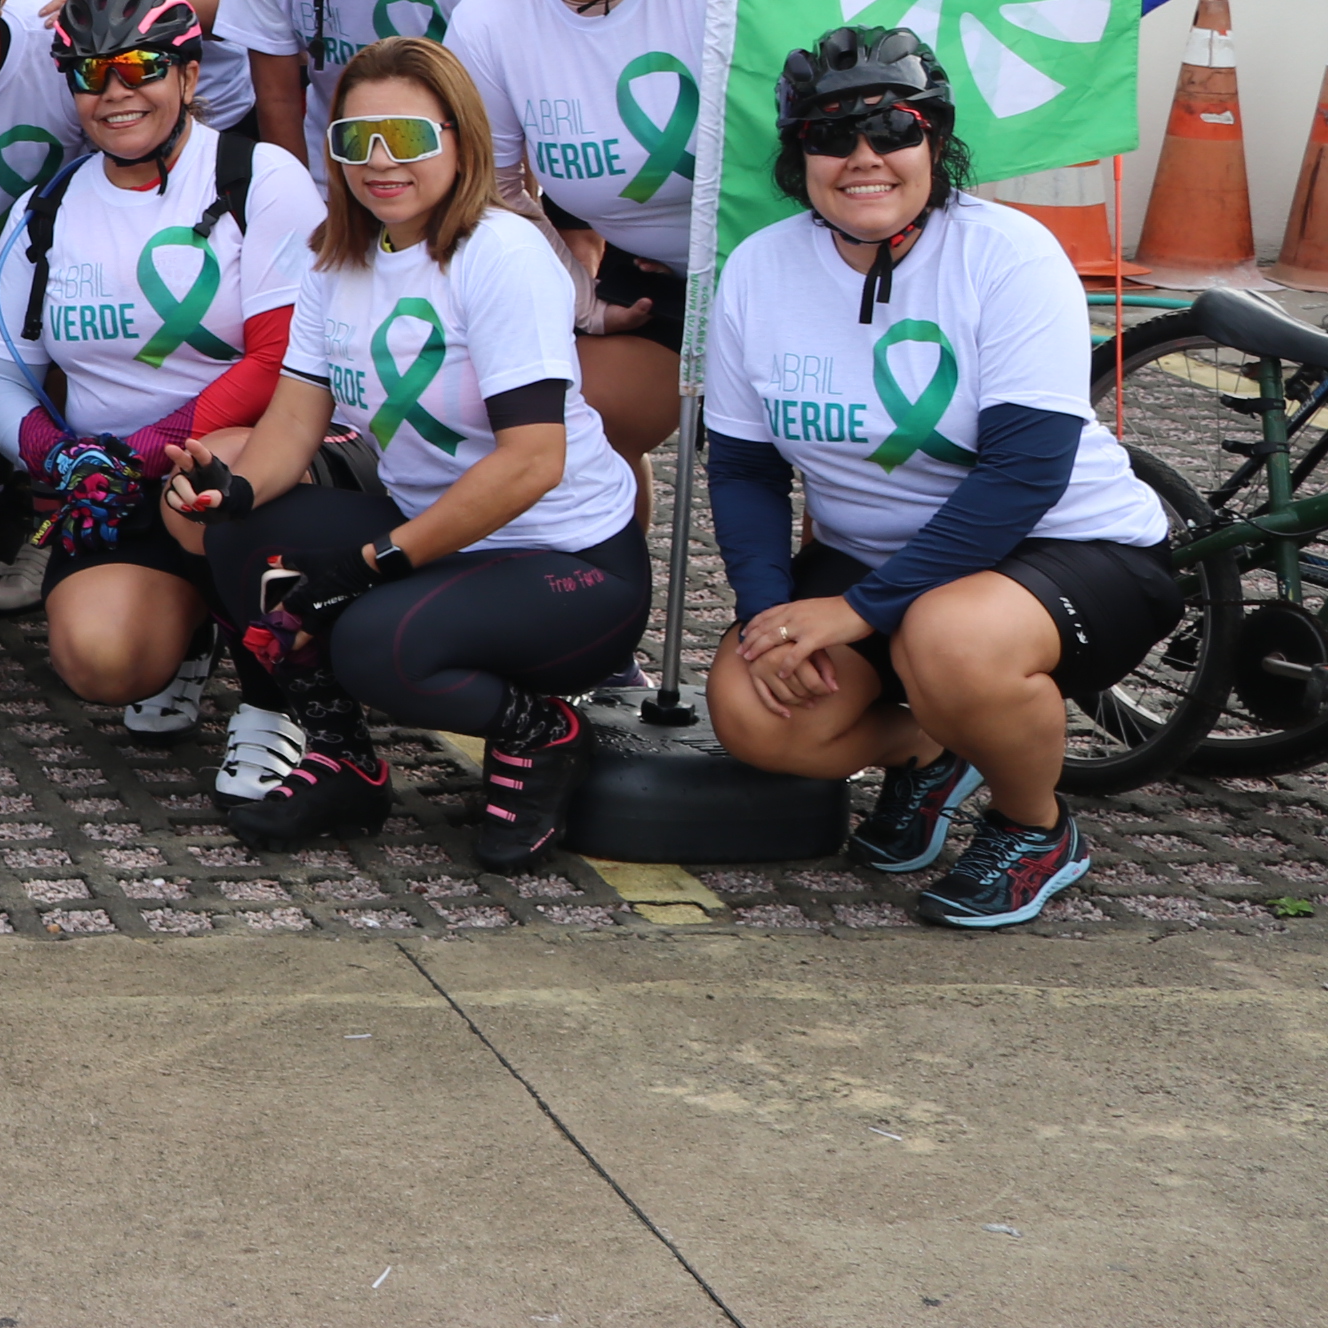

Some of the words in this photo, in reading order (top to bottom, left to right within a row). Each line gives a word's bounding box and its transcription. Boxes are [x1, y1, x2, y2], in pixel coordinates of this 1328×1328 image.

[524, 99, 594, 135] ABRIL
[536, 138, 627, 180] VERDE
[49, 262, 113, 298] ABRIL
[49, 302, 140, 342] VERDE
[324, 317, 356, 361] BRIL
[769, 352, 843, 395] ABRIL
[763, 400, 869, 444] VERDE
